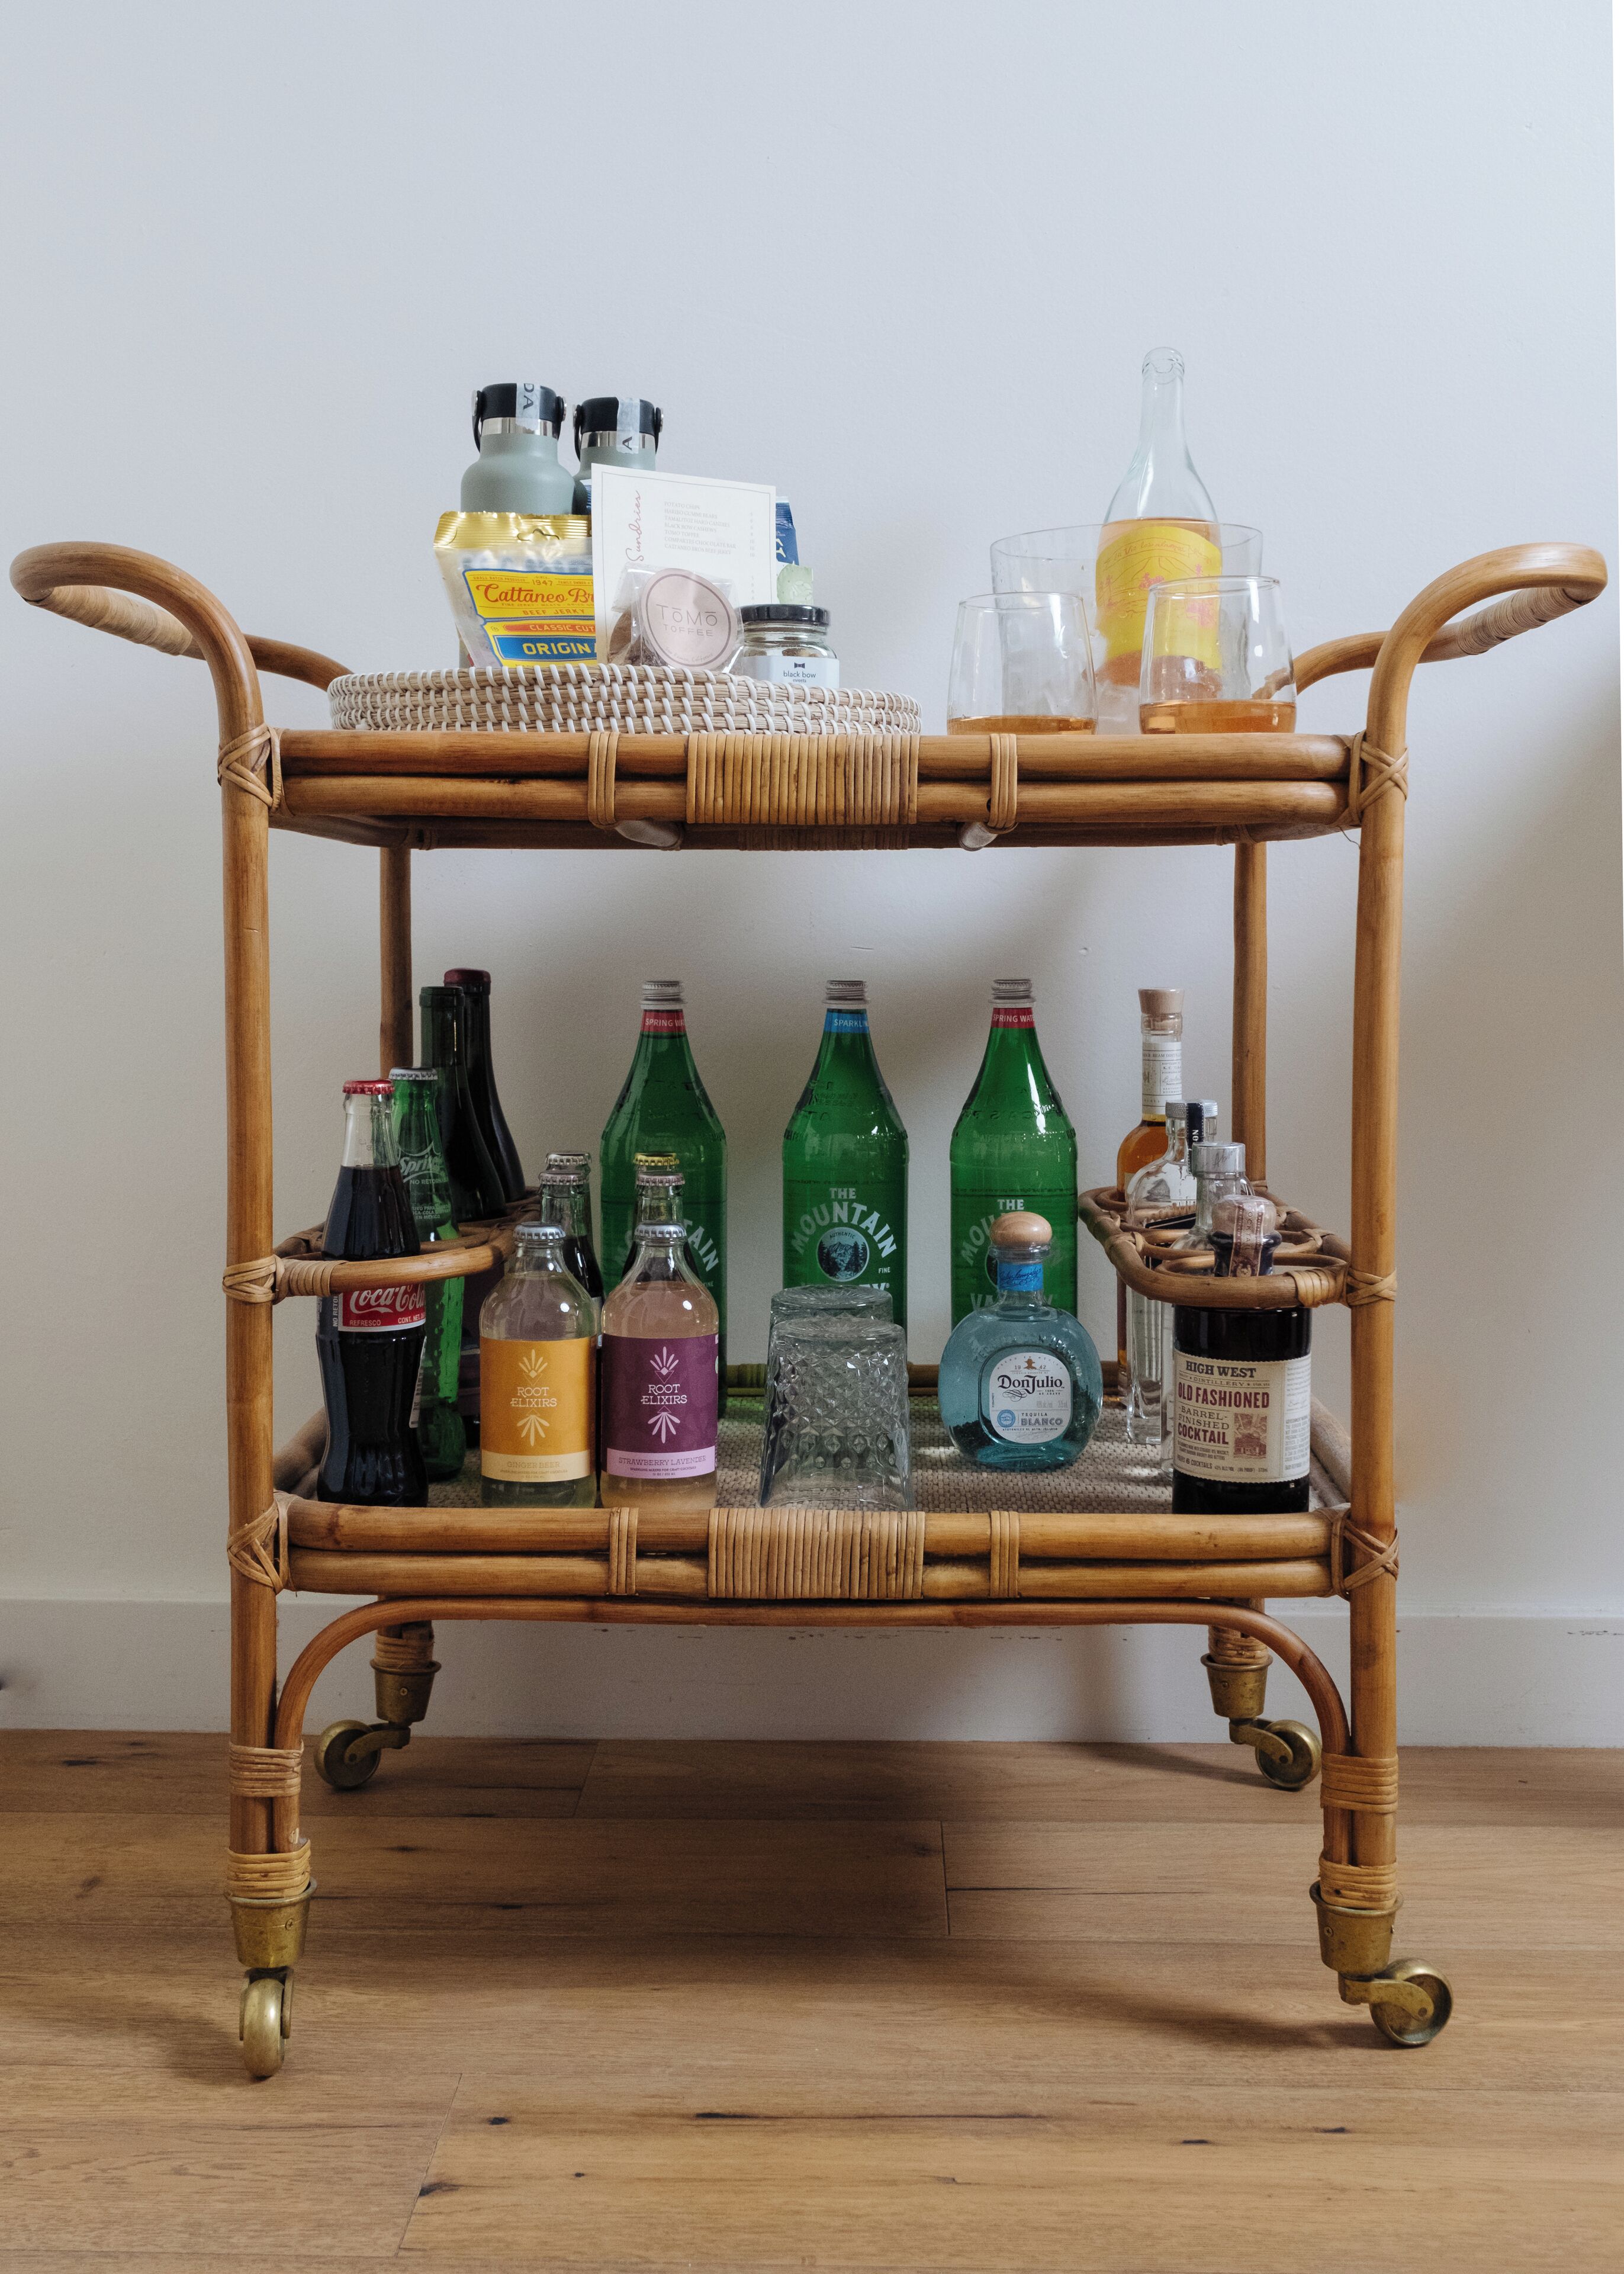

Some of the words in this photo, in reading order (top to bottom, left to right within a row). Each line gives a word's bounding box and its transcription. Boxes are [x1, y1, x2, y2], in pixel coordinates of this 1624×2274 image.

[625, 490, 644, 561] Sundries
[475, 583, 568, 603] Cattaneo
[568, 588, 594, 603] Br
[663, 624, 713, 637] TOFFEE
[522, 643, 596, 655] ORIGIN
[645, 1018, 673, 1027] SPRING
[993, 1014, 1018, 1023] SPRING
[1020, 1014, 1035, 1023] WATE
[829, 1187, 856, 1199] THE
[997, 1199, 1024, 1210] THE
[791, 1201, 897, 1258] MOUNTAIN
[349, 1284, 426, 1314] Coca-Cola
[332, 1317, 339, 1327] NO
[1186, 1360, 1214, 1376] HIGH
[1216, 1366, 1256, 1378] WEST
[1194, 1376, 1244, 1386] DISTILLERY
[517, 1387, 549, 1396] ROOT
[648, 1384, 680, 1394] ROOT
[641, 1395, 687, 1405] ELIXIRS
[1178, 1382, 1193, 1401] OLD
[1196, 1387, 1270, 1409] FASHIONED
[510, 1398, 557, 1407] ELIXIRS
[1021, 1418, 1063, 1426] BLANCO
[1178, 1414, 1229, 1430] FINISHED
[1178, 1422, 1229, 1445] COCKTAIL
[619, 1457, 669, 1466] STRAWBERRY
[671, 1456, 706, 1465] LAVENDER
[1191, 1460, 1213, 1469] COCKTAILS
